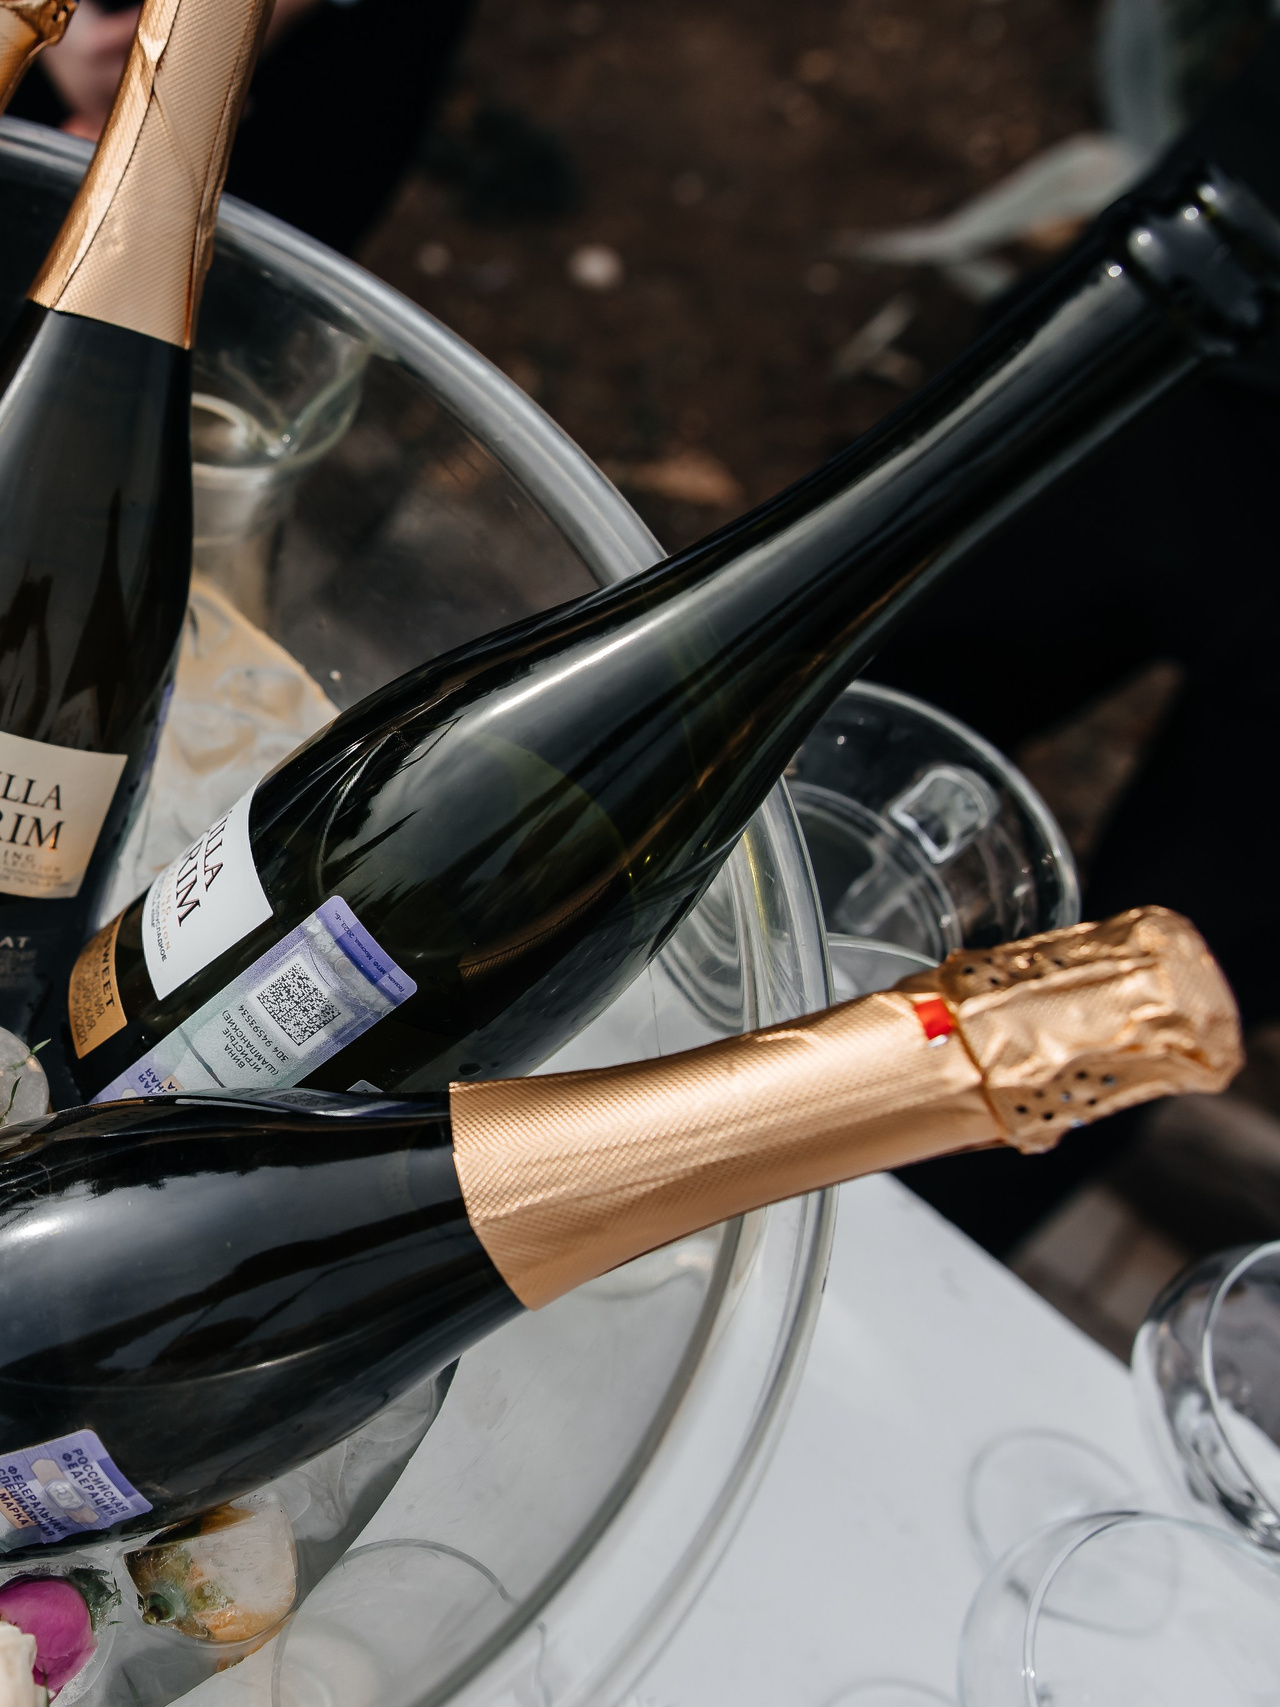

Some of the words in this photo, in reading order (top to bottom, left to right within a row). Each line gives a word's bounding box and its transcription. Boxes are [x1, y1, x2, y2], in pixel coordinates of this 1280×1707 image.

[176, 834, 204, 927] RIM
[203, 811, 232, 892] ILLA
[222, 1009, 279, 1076] (ШАМПАНСКИЕ)
[222, 1027, 262, 1073] ИГРИСТЫЕ
[224, 1043, 246, 1069] ВИНА
[238, 1004, 273, 1048] 94593534
[272, 1046, 289, 1063] 304
[8, 1465, 67, 1533] ФЕДЕРАЛЬНАЯ
[62, 1453, 119, 1517] ФЕДЕРАЦИЯ
[72, 1448, 129, 1513] РОССИЙСКАЯ
